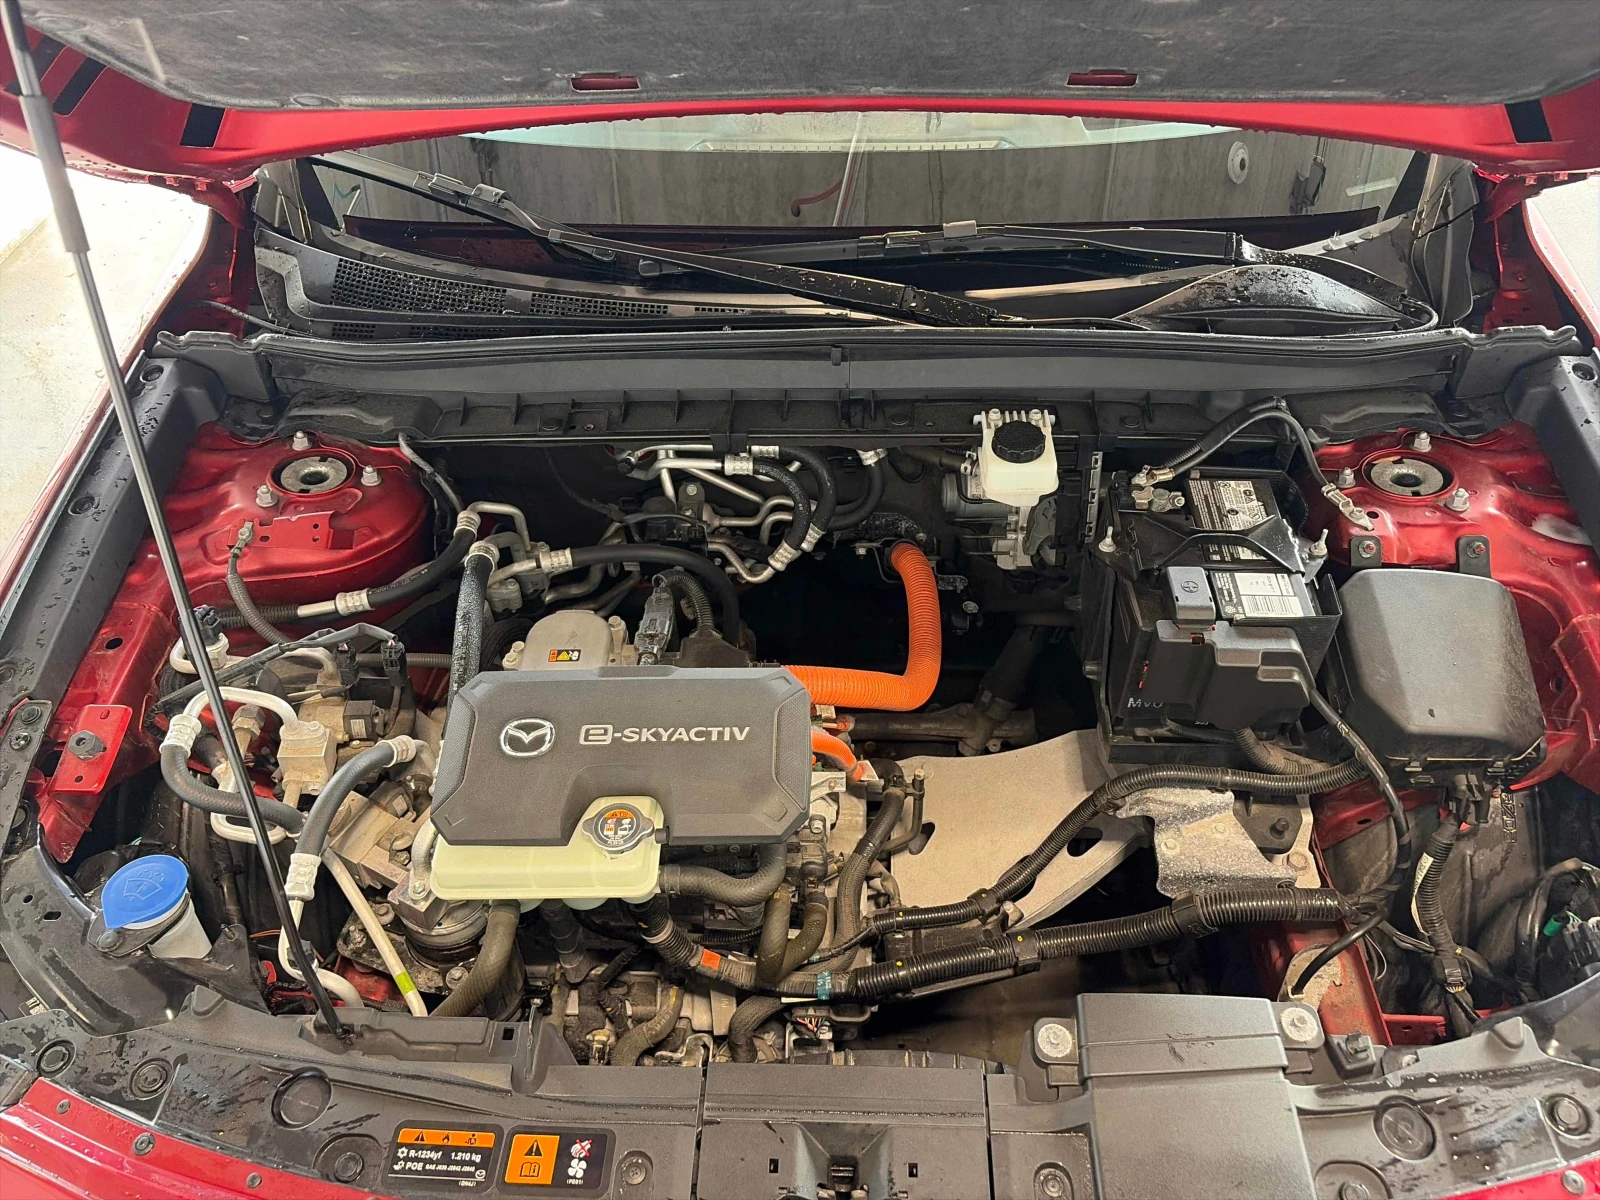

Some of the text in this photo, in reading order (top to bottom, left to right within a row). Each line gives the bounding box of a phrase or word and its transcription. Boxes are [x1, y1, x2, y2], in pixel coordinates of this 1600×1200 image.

[408, 1149, 482, 1163] R-1234yf 1.210 kg
[405, 1162, 424, 1170] POE
